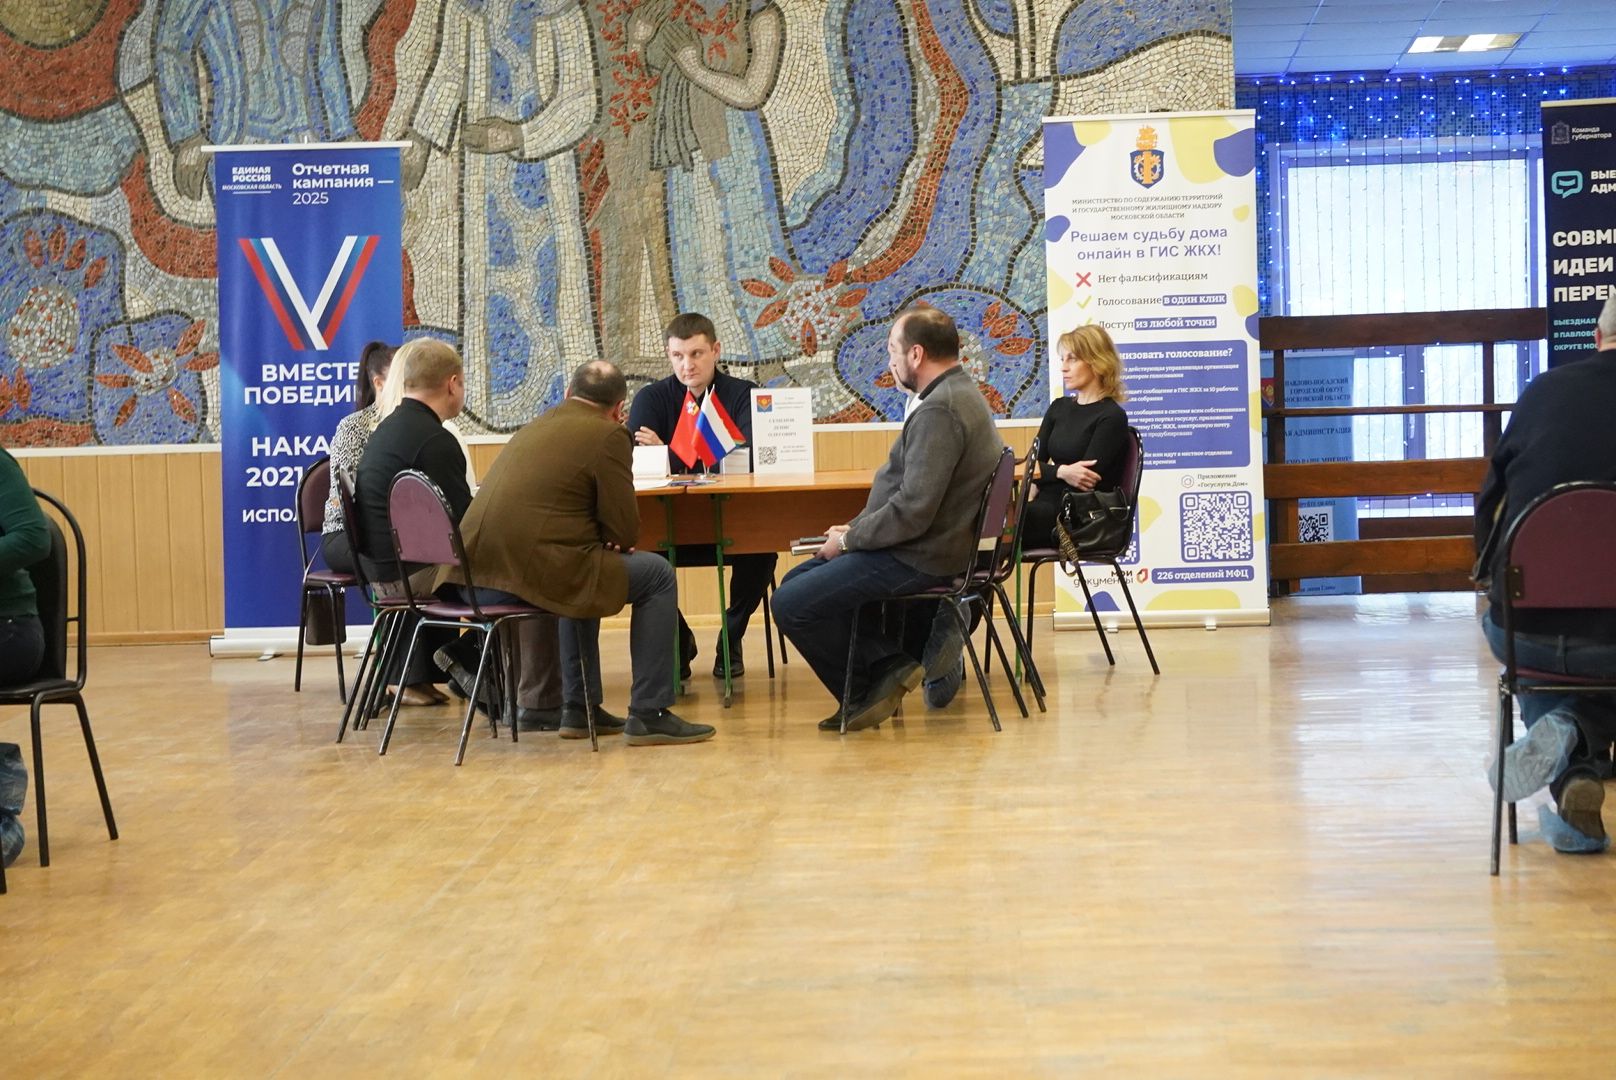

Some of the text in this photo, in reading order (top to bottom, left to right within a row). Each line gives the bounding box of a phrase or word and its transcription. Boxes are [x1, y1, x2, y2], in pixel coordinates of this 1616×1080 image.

[232, 166, 271, 175] ЕДИНАЯ
[292, 163, 369, 176] Отчетная
[232, 174, 271, 183] РОССИЯ
[292, 177, 374, 189] кампания
[292, 192, 329, 205] 2025
[1072, 197, 1122, 205] МИНИСТЕРСТВО
[1134, 195, 1181, 203] СОДЕРЖАНИЮ
[1181, 193, 1223, 201] ТЕРРИТОРИЙ
[1145, 203, 1191, 211] ЖИЛИЩНОМУ
[1192, 202, 1222, 210] НАДЗОРУ
[1111, 213, 1154, 221] МОСКОВСКОЙ
[1071, 227, 1227, 243] Решаем судьбу дома
[1552, 229, 1616, 247] СОВМ
[1077, 243, 1222, 260] онлайн в ГИС ЖКХ!
[1553, 256, 1614, 277] ИДЕИ
[1098, 272, 1208, 285] Нет фальсификациям
[1097, 296, 1162, 306] Голосование
[1171, 296, 1197, 306] один
[1199, 294, 1227, 303] клик
[1099, 320, 1134, 331] Доступ
[1149, 318, 1184, 329] любой
[1185, 318, 1215, 327] точки
[1553, 318, 1597, 326] ВЫЕЗДНАЯ
[1119, 348, 1233, 360] низовать голосование?
[262, 363, 359, 382] ВМЕСТЕ
[244, 385, 357, 406] ПОБЕДИ
[252, 436, 331, 457] НАКА
[1157, 570, 1249, 580] 226 отделений МФЦ
[1073, 576, 1134, 587] дкумены
